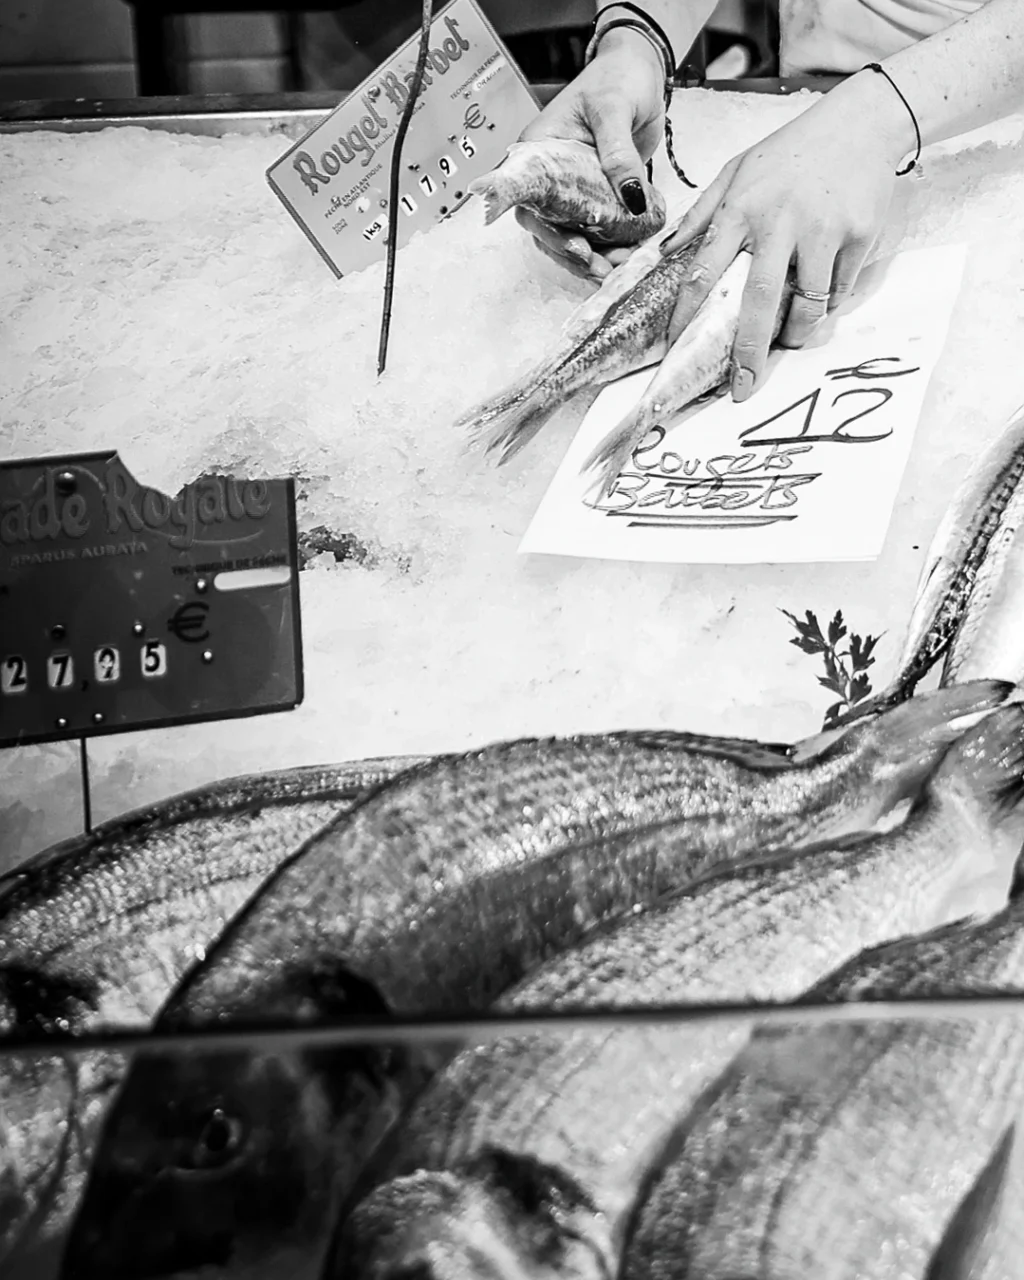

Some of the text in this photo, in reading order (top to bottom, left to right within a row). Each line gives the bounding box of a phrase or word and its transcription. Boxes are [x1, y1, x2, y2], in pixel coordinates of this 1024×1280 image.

[464, 102, 487, 131] €
[292, 93, 388, 197] Rouget
[349, 163, 383, 196] ATLANTIQUE
[104, 466, 271, 549] Royale
[167, 600, 211, 643] €
